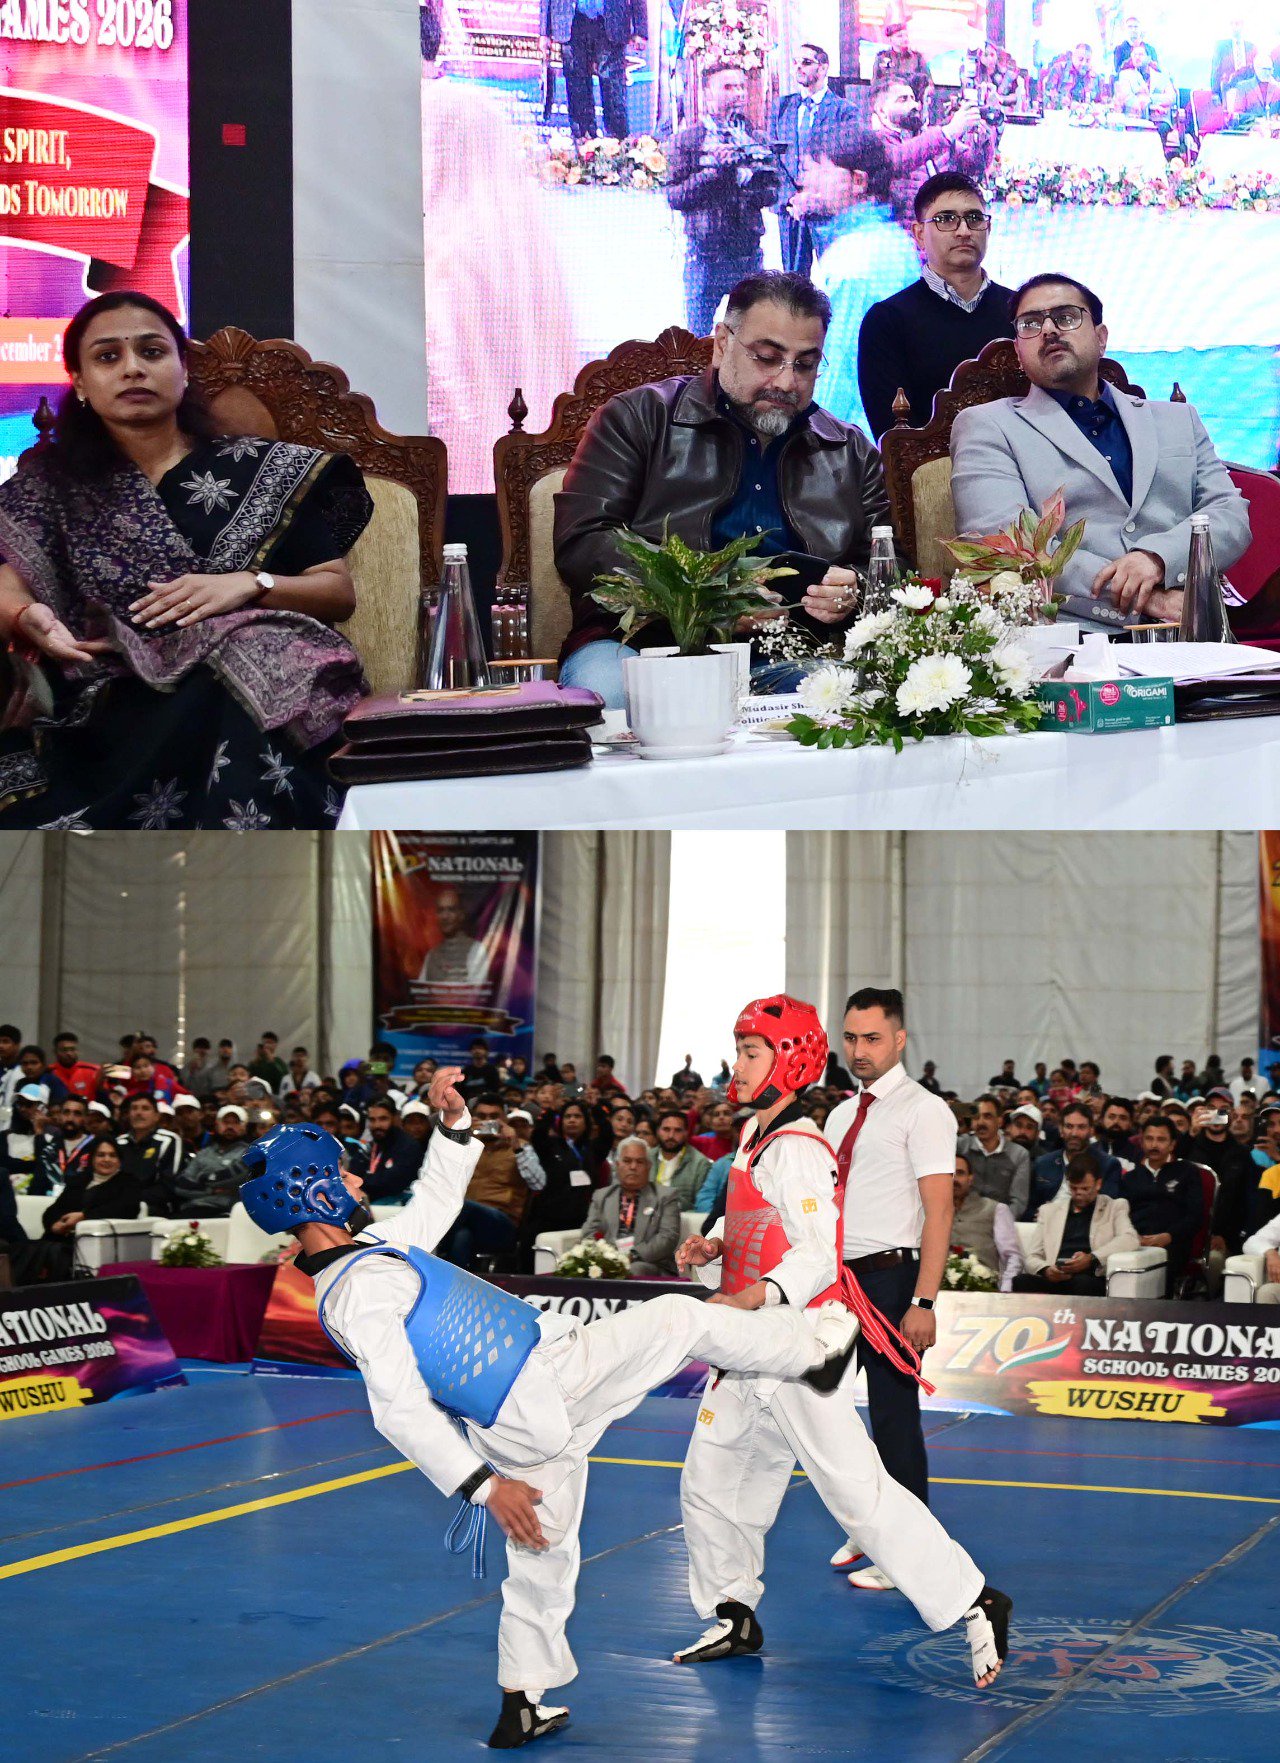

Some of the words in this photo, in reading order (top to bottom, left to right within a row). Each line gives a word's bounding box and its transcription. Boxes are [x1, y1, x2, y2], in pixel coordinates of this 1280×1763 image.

[97, 0, 173, 49] 2026
[3, 127, 71, 171] SPIRIT,
[428, 856, 524, 872] NATIONAL
[1053, 1308, 1076, 1324] th
[945, 1316, 1050, 1371] 70
[1083, 1358, 1170, 1378] SCHOOL
[1172, 1362, 1250, 1382] GAMES
[1067, 1387, 1185, 1414] WUSHU
